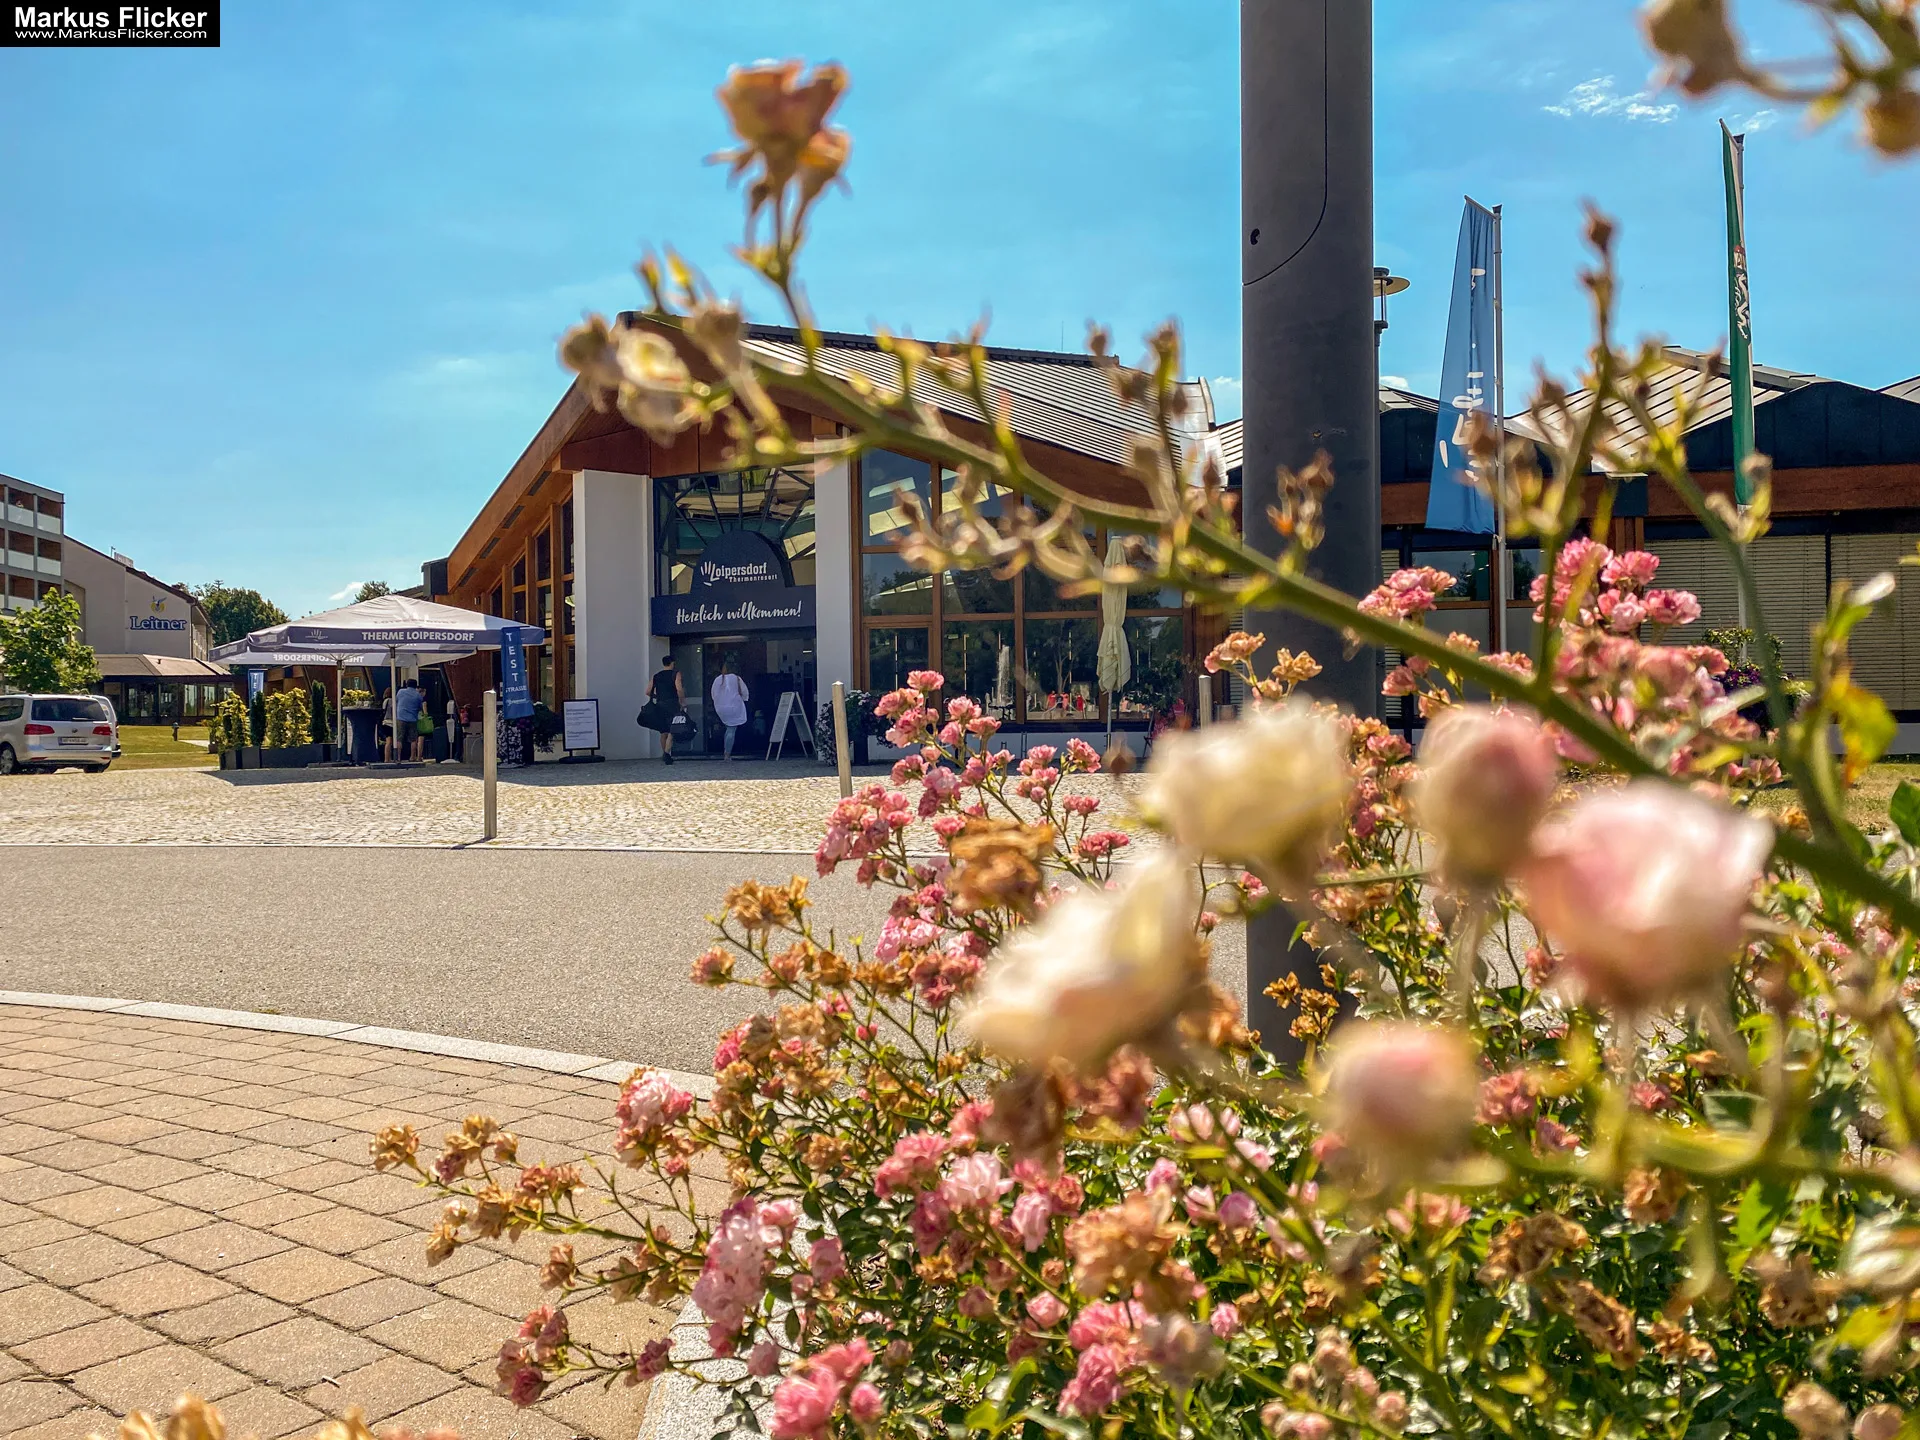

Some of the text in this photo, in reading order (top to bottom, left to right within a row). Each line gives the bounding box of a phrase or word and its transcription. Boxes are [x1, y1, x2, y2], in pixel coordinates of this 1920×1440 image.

[710, 562, 768, 582] Loipersdorf
[729, 574, 778, 583] Thermenresort
[676, 600, 802, 625] Herzlich willkommen!
[130, 615, 187, 630] Leitner
[362, 631, 475, 642] THERME LOIPERSDORF
[506, 632, 518, 682] TEST
